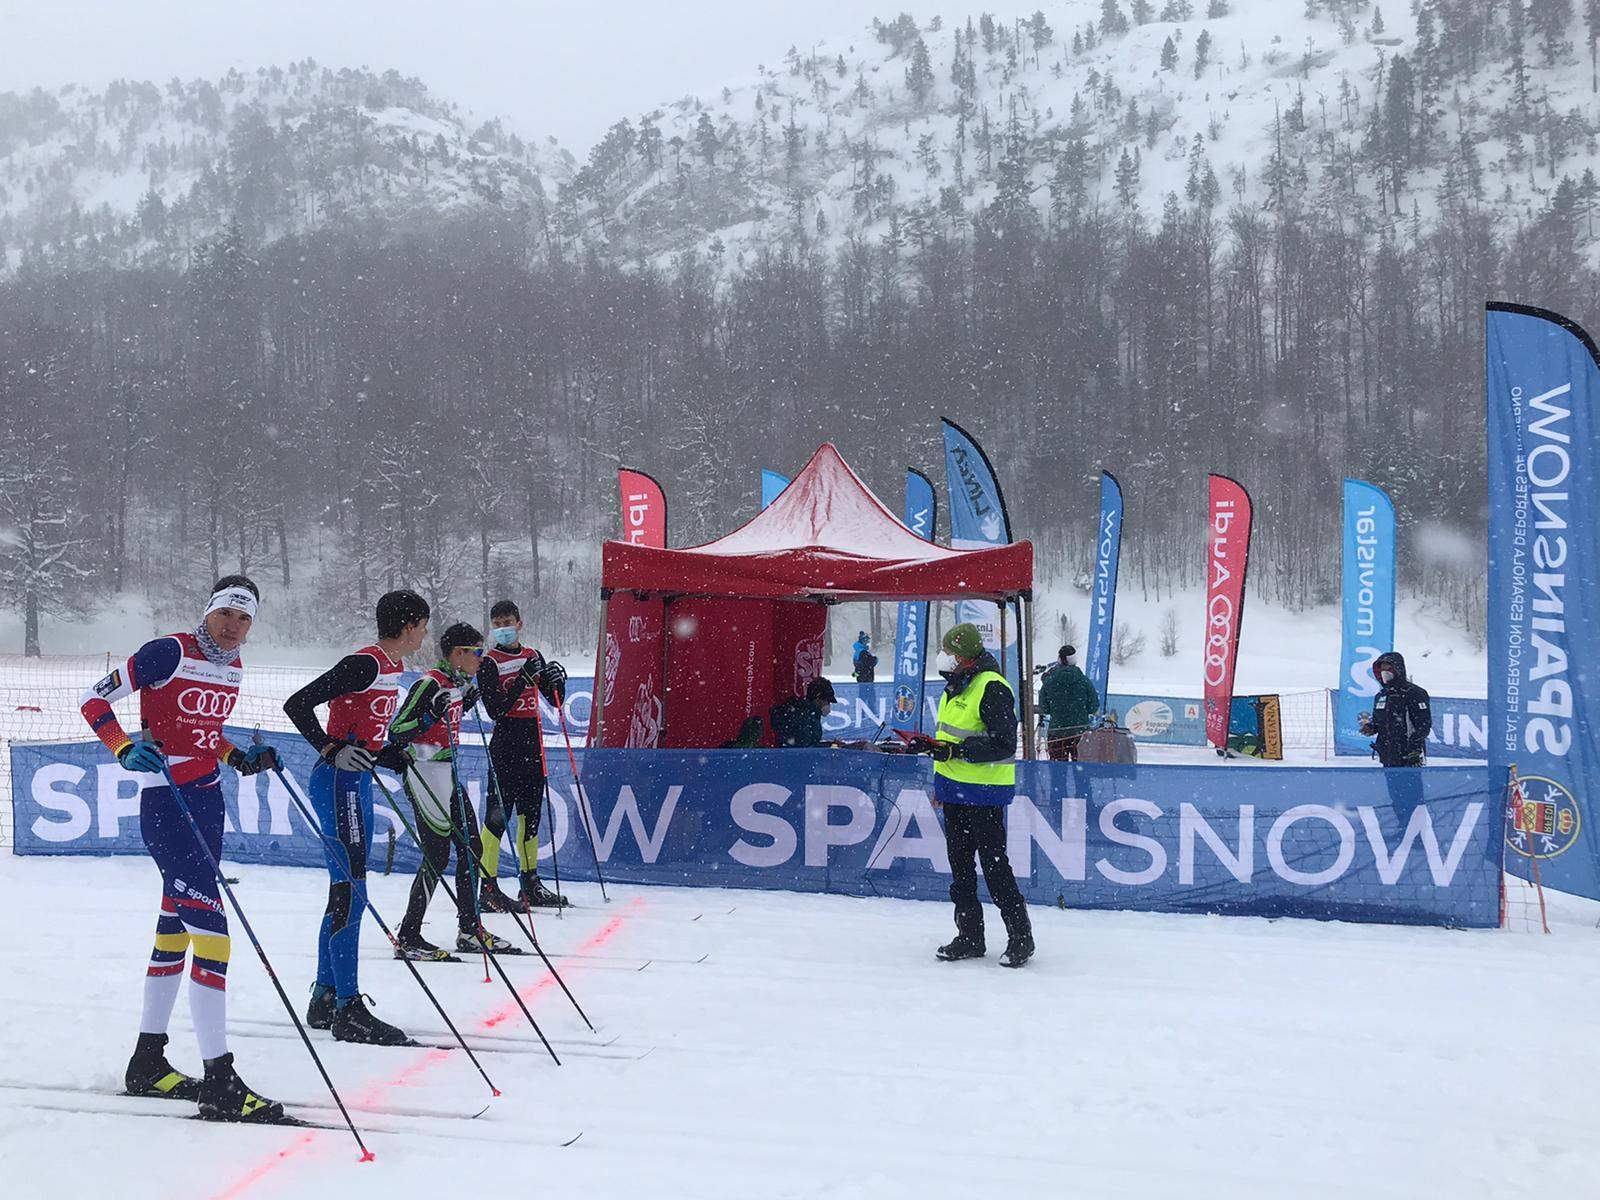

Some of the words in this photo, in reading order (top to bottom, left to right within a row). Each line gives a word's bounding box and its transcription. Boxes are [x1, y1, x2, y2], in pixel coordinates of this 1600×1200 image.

[517, 697, 537, 711] 23
[176, 716, 197, 726] Audi
[1429, 713, 1488, 750] IN
[728, 782, 1483, 887] SPANSNOW
[187, 888, 226, 917] sportfu
